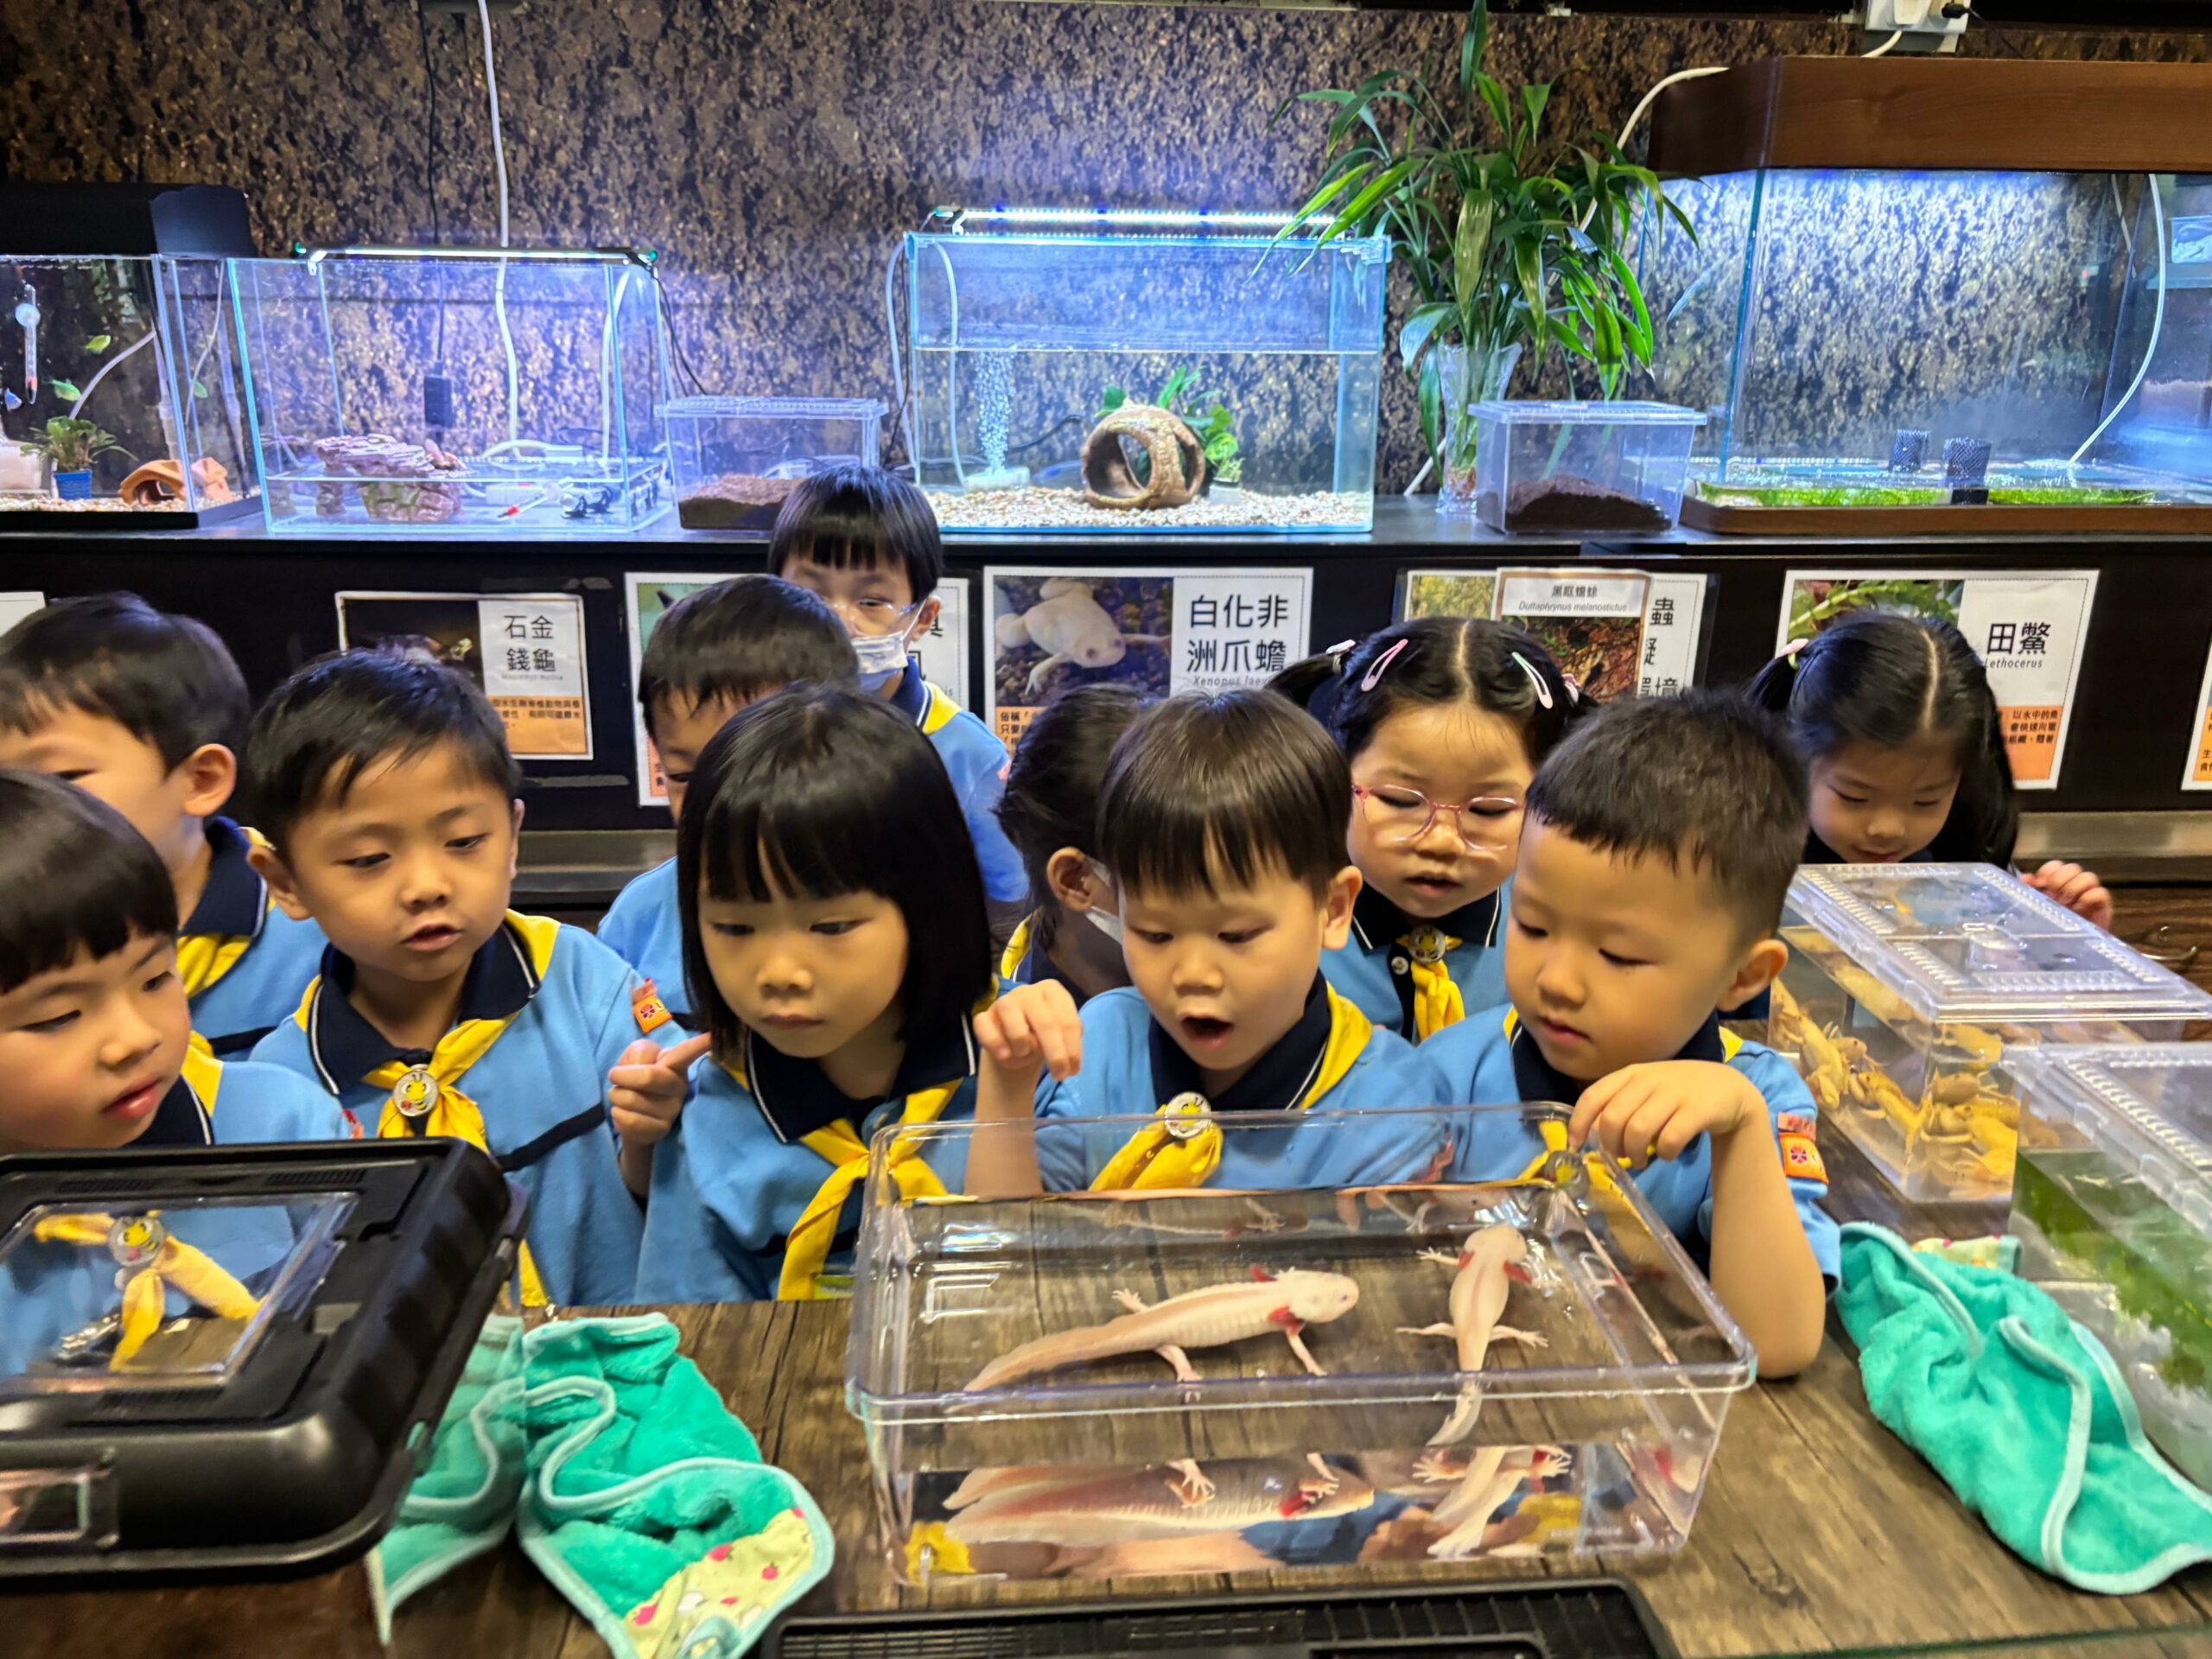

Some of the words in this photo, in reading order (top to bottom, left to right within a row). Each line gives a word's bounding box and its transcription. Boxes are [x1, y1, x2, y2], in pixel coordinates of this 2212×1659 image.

[1191, 594, 1288, 628] 白化非
[1518, 601, 1572, 612] Duttaphrynus
[504, 615, 554, 639] 石金
[1986, 622, 2051, 654] 田鱉
[506, 648, 556, 671] 錢龜
[1186, 639, 1286, 672] 洲爪蟾
[1193, 676, 1241, 688] Xenopus
